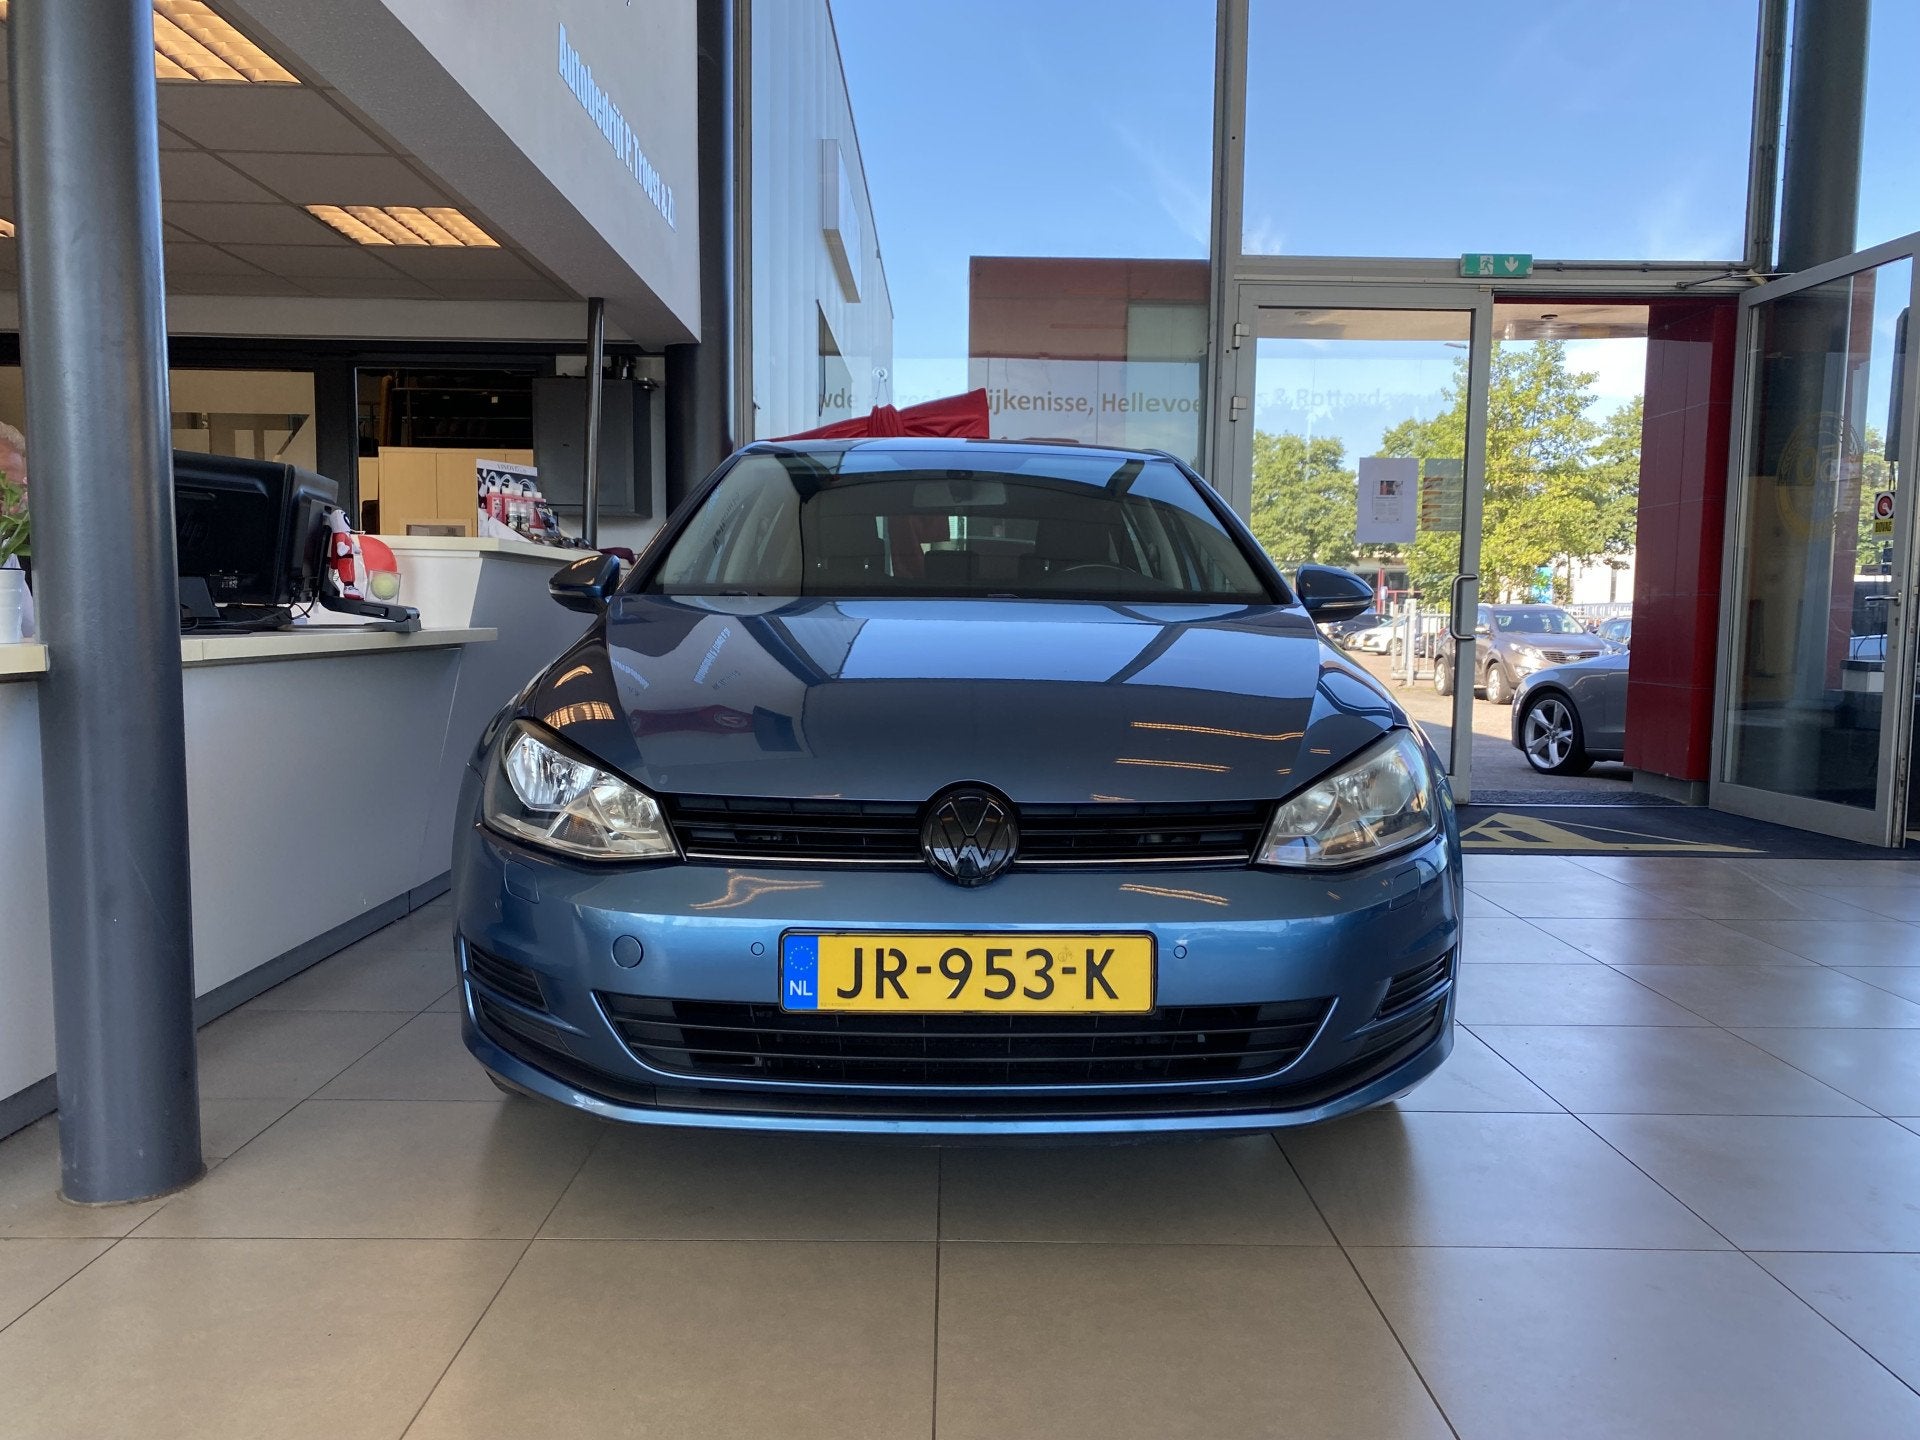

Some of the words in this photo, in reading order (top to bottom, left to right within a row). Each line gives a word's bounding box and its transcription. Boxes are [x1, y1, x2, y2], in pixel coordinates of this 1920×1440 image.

[558, 22, 624, 160] Autobedrijf
[632, 134, 661, 210] Troost
[989, 388, 1094, 416] ijkenisse,
[1102, 392, 1202, 412] Hellevoe
[789, 981, 813, 996] NL
[837, 948, 1119, 1000] JR-953-K
